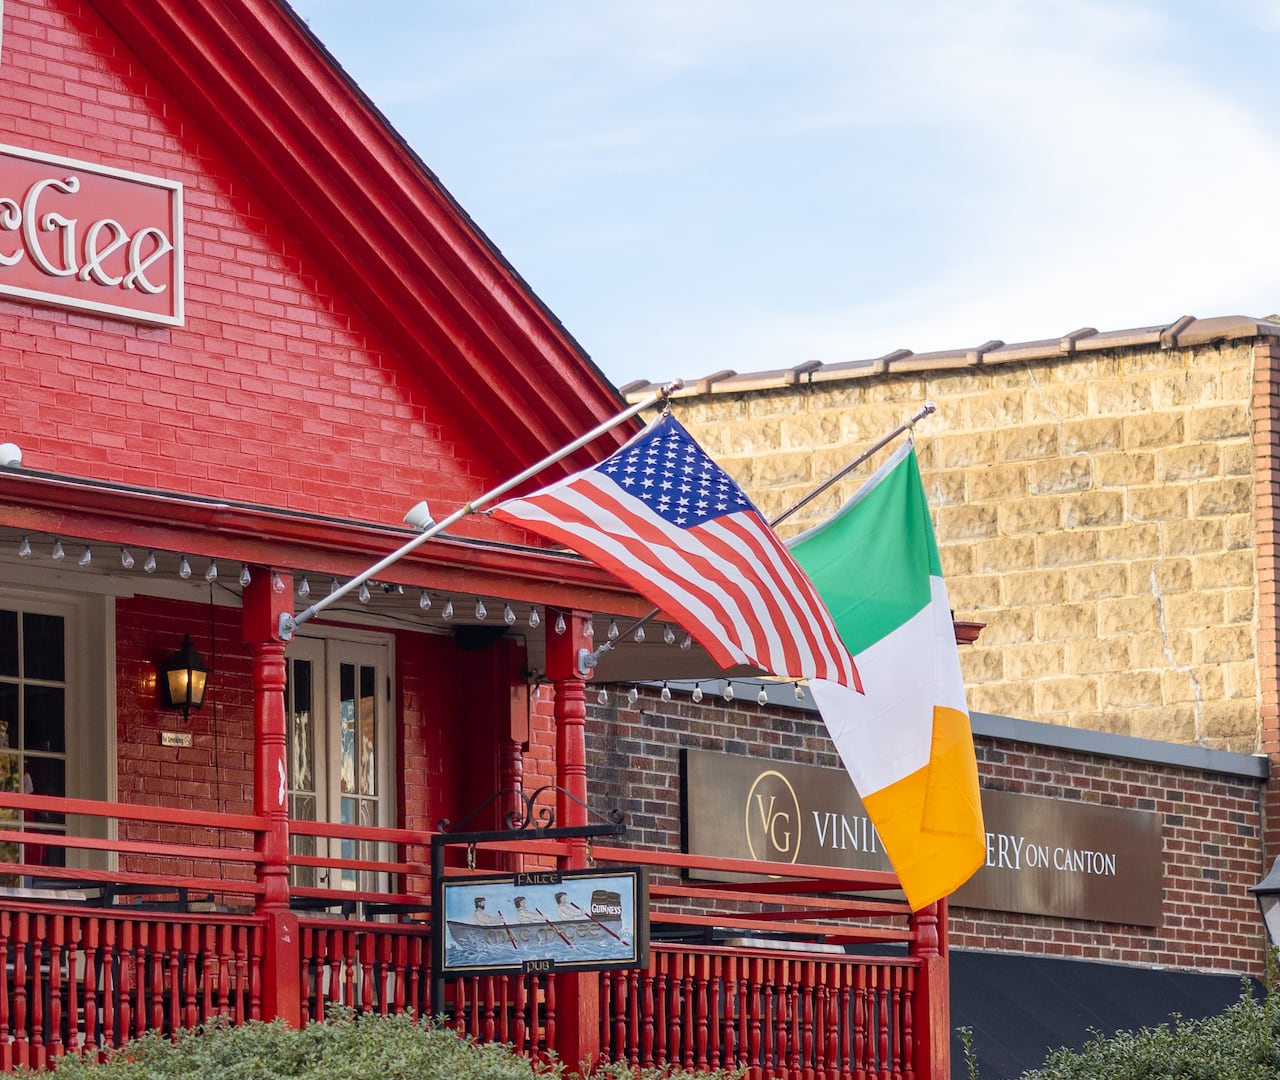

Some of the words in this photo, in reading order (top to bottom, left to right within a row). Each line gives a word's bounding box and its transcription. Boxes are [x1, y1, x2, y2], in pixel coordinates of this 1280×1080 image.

[755, 794, 791, 853] VG
[1025, 843, 1049, 869] ON
[1053, 847, 1116, 877] CANTON
[591, 903, 621, 916] GUINNESS
[526, 961, 550, 972] PUB
